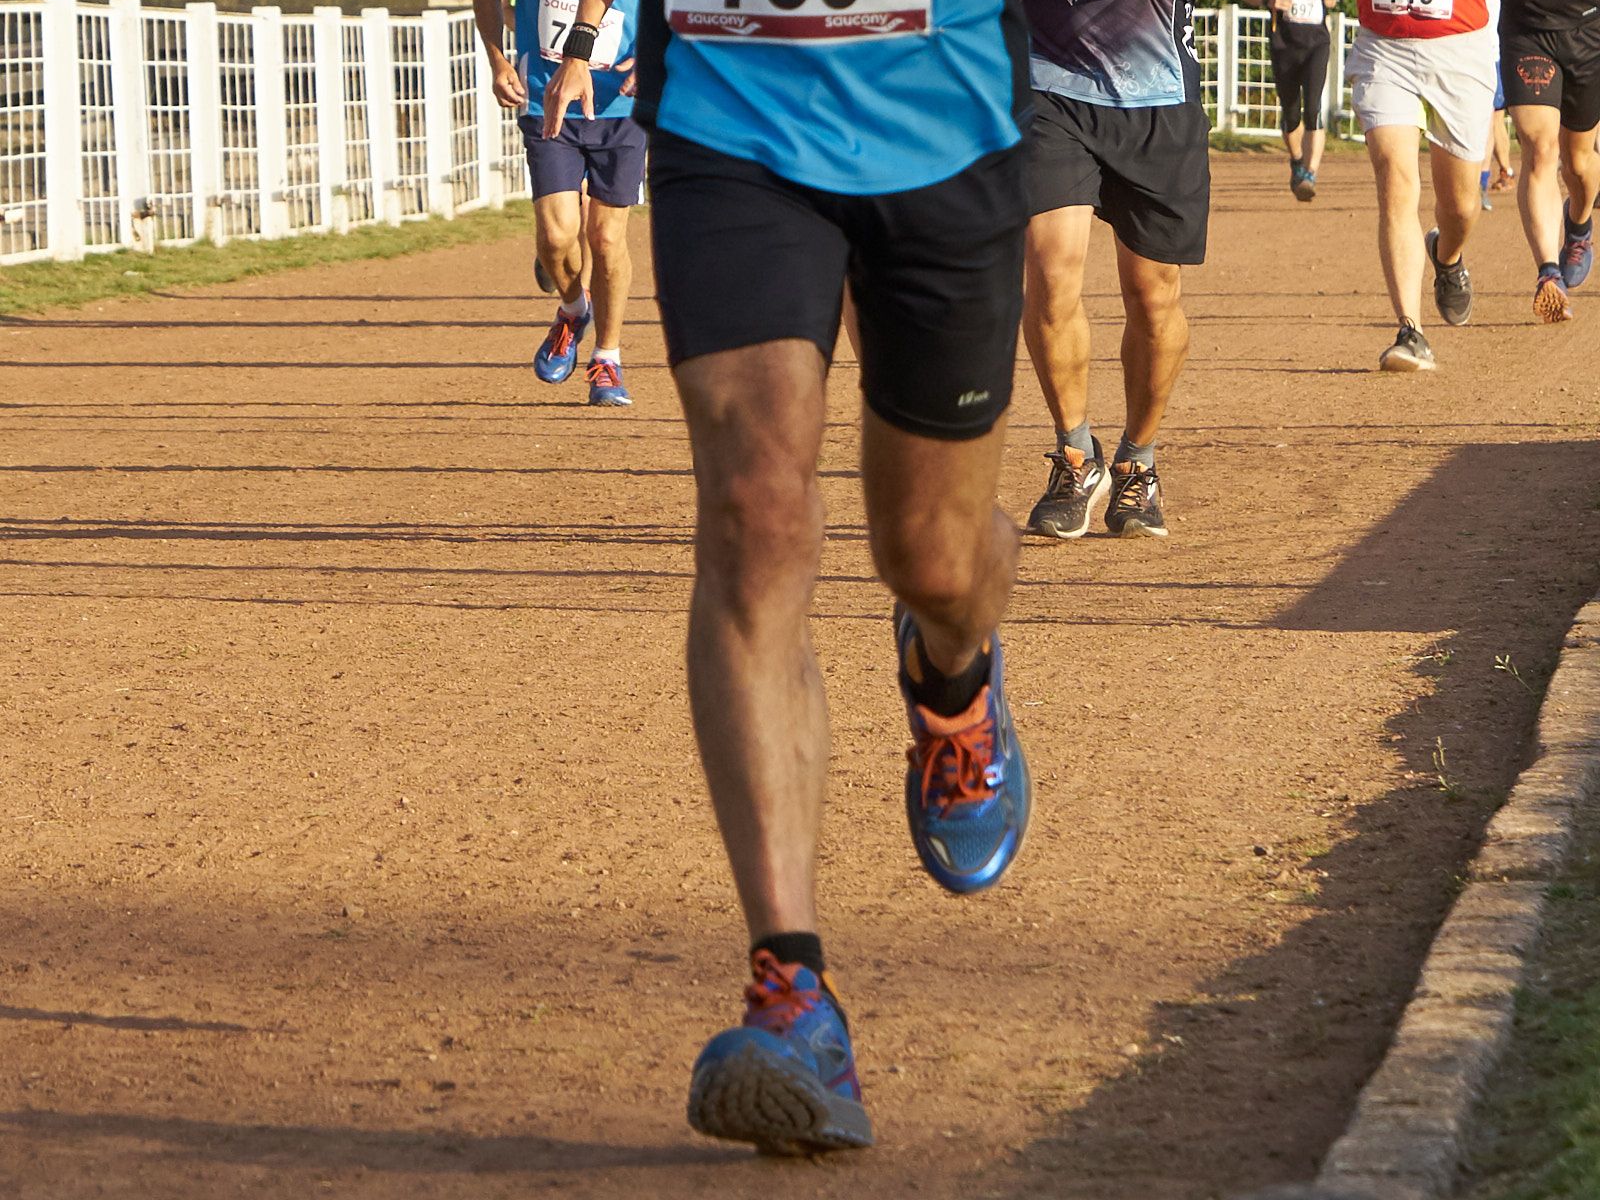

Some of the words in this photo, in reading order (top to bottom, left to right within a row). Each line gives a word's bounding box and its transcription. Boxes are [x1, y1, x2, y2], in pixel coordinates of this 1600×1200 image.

[1291, 3, 1314, 17] 697
[687, 12, 745, 27] saucony
[825, 12, 889, 28] saucony
